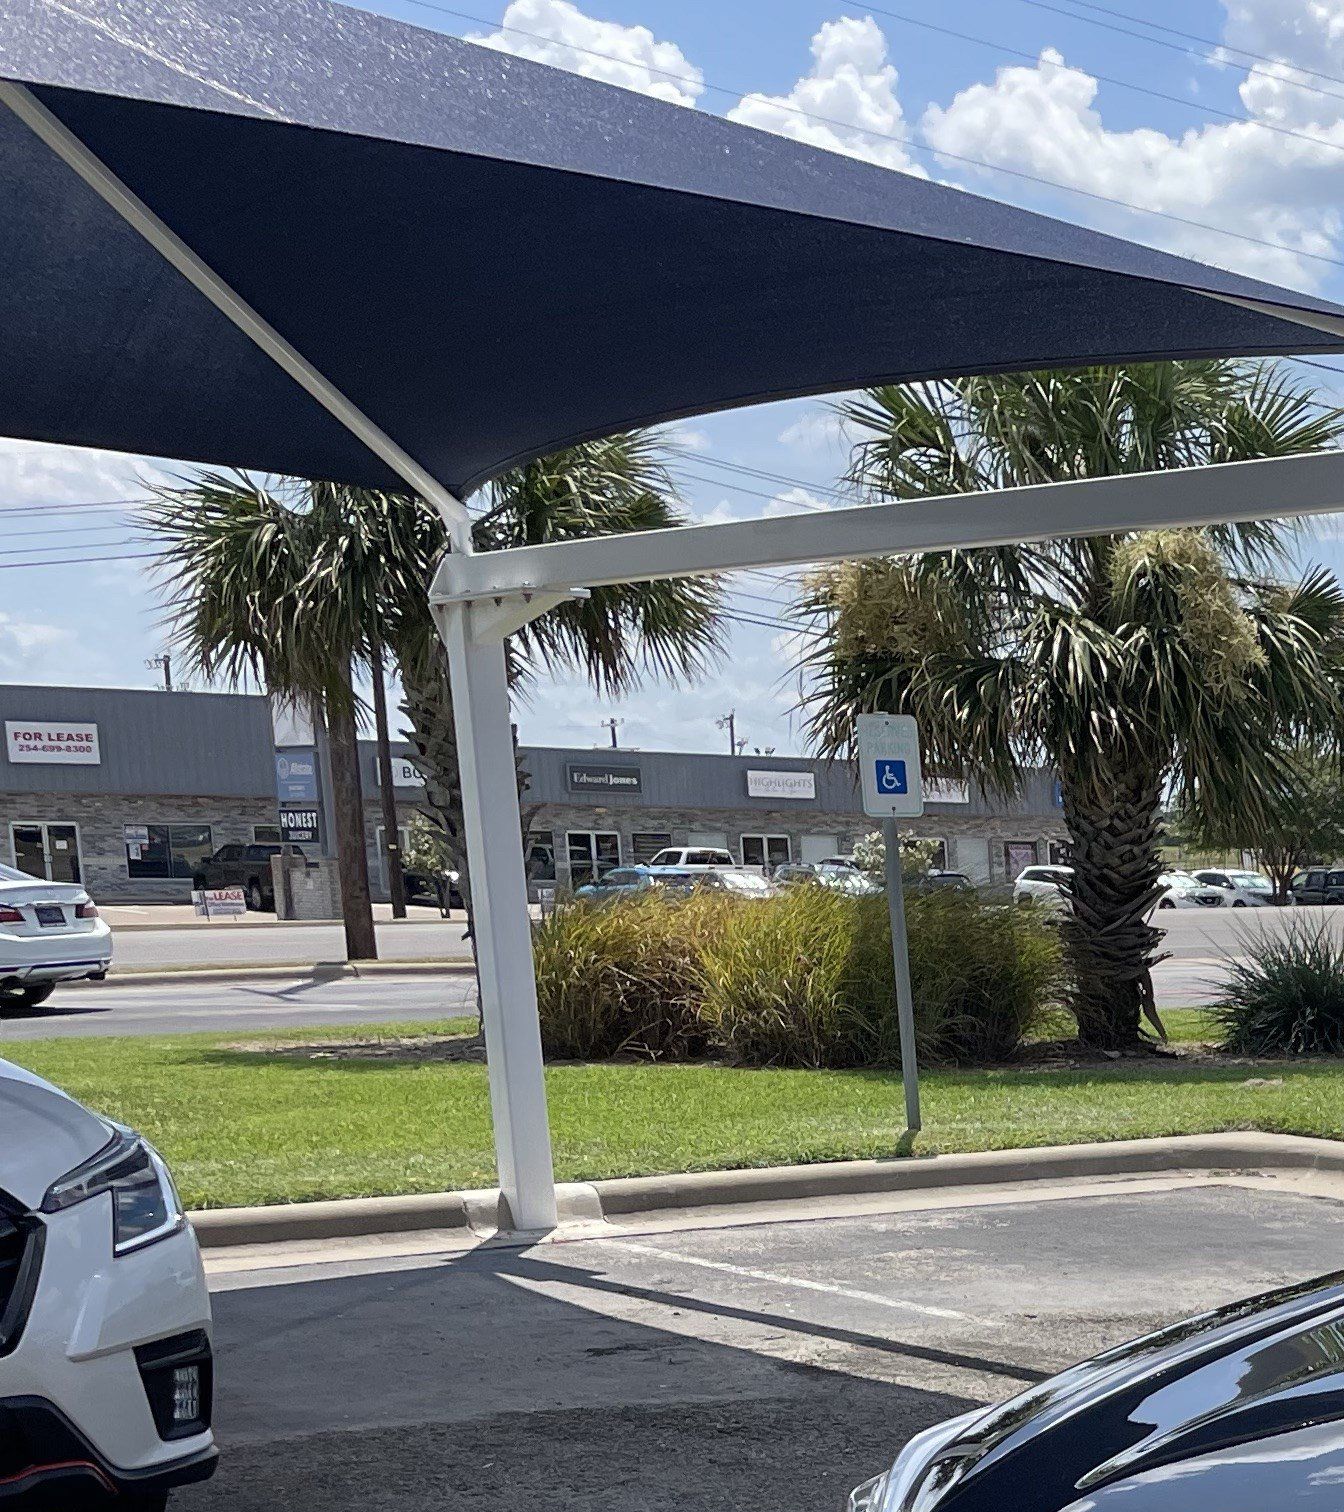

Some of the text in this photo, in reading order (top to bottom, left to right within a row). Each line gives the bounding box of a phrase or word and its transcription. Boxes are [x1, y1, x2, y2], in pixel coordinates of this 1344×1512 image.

[13, 731, 94, 743] FOR LEASE
[867, 742, 911, 755] PARKING
[573, 772, 638, 785] Edward Jones
[749, 776, 813, 788] HIGHLIGHTS
[280, 812, 317, 828] HONEST
[213, 891, 242, 901] LEASE
